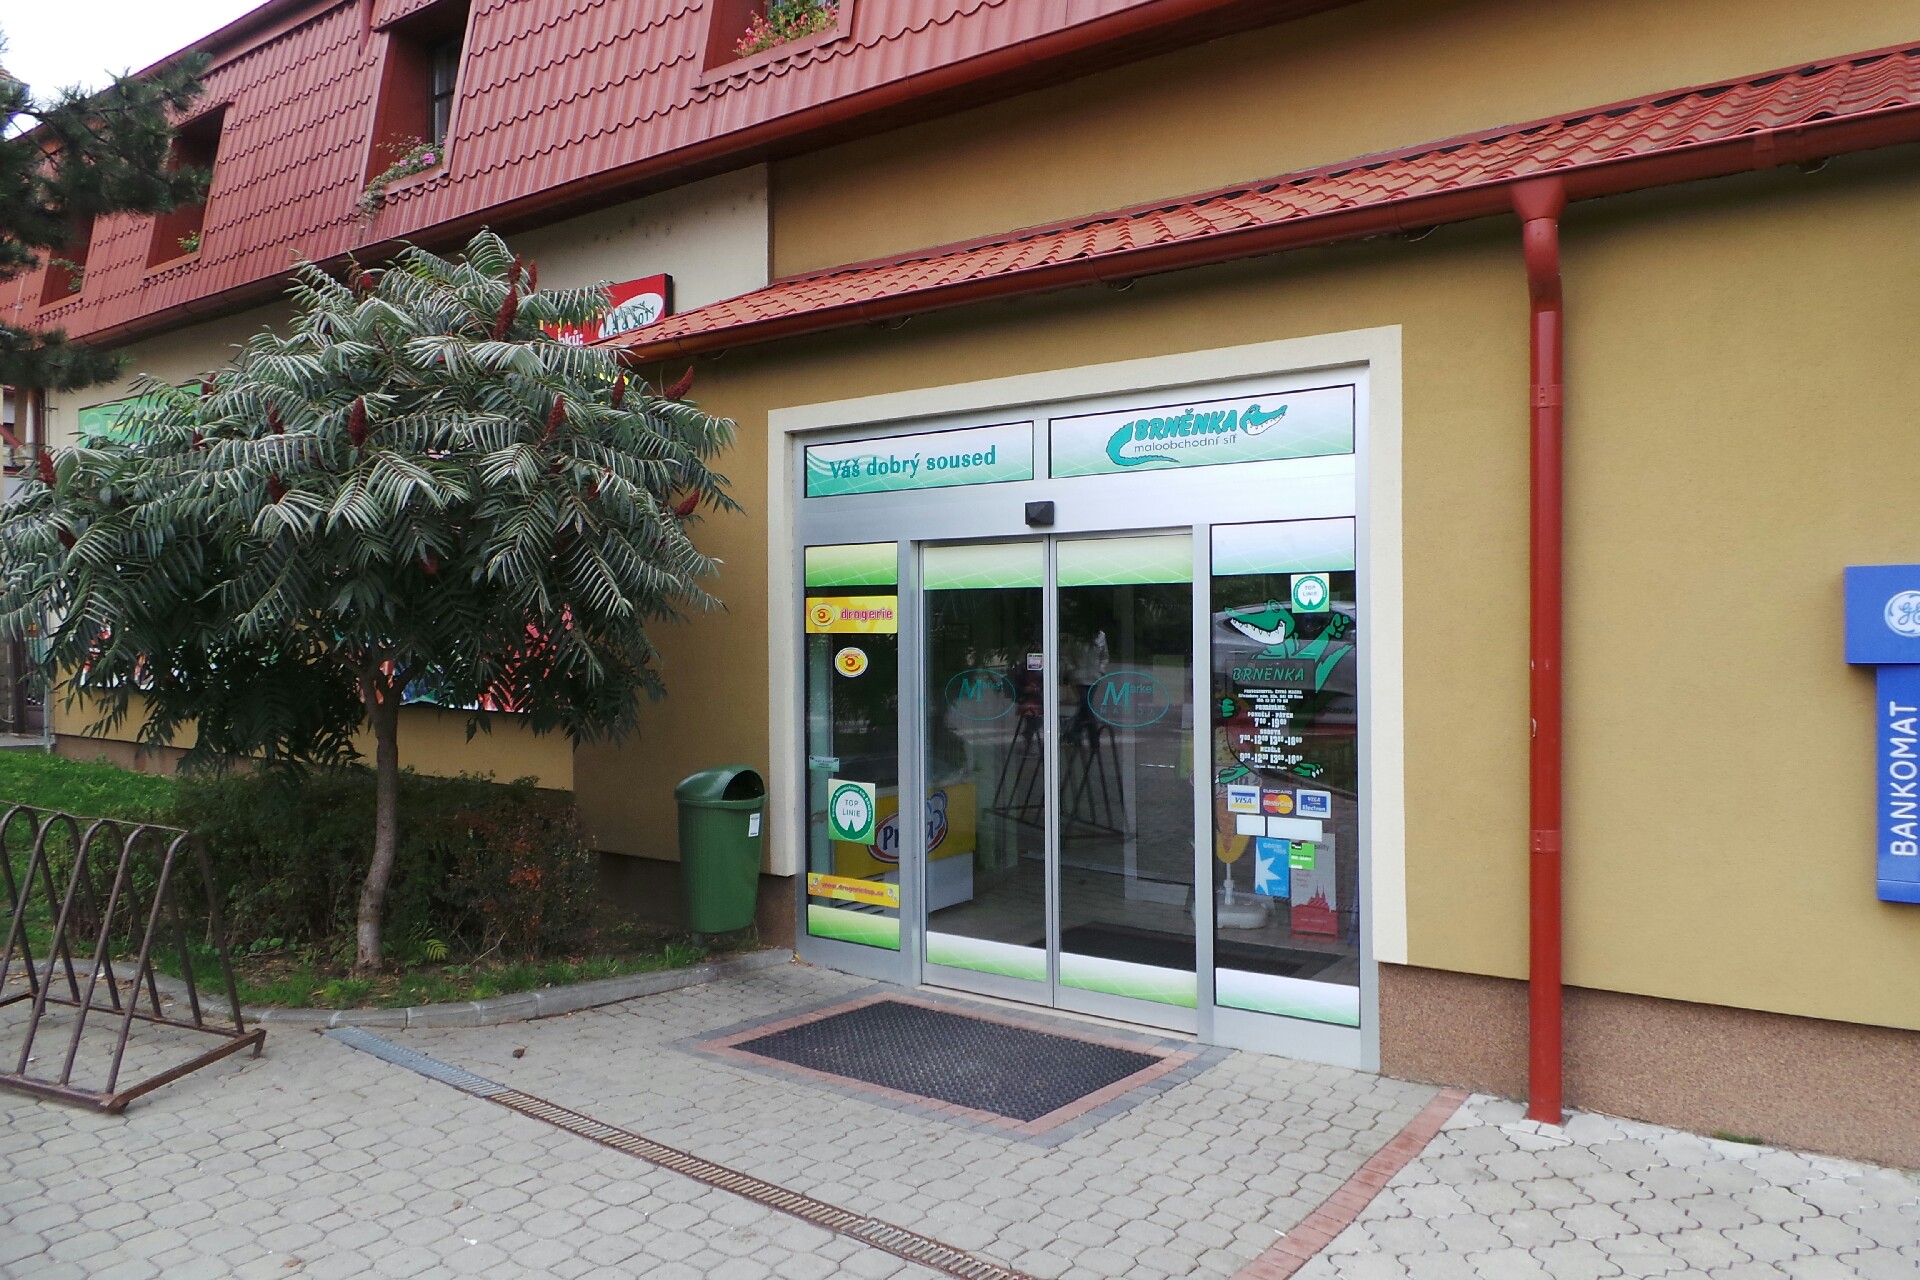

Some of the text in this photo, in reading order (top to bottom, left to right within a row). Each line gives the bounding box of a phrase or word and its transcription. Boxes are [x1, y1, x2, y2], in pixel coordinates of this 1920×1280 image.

[1134, 408, 1238, 441] BRNĚNKA
[1134, 433, 1237, 453] maloobchodní síť
[829, 445, 996, 479] Váš dobrý soused
[841, 608, 893, 622] drogerie
[1889, 701, 1918, 856] BANKOMAT
[845, 799, 859, 807] TOP
[1234, 796, 1252, 804] VISA
[842, 808, 861, 817] LINIE
